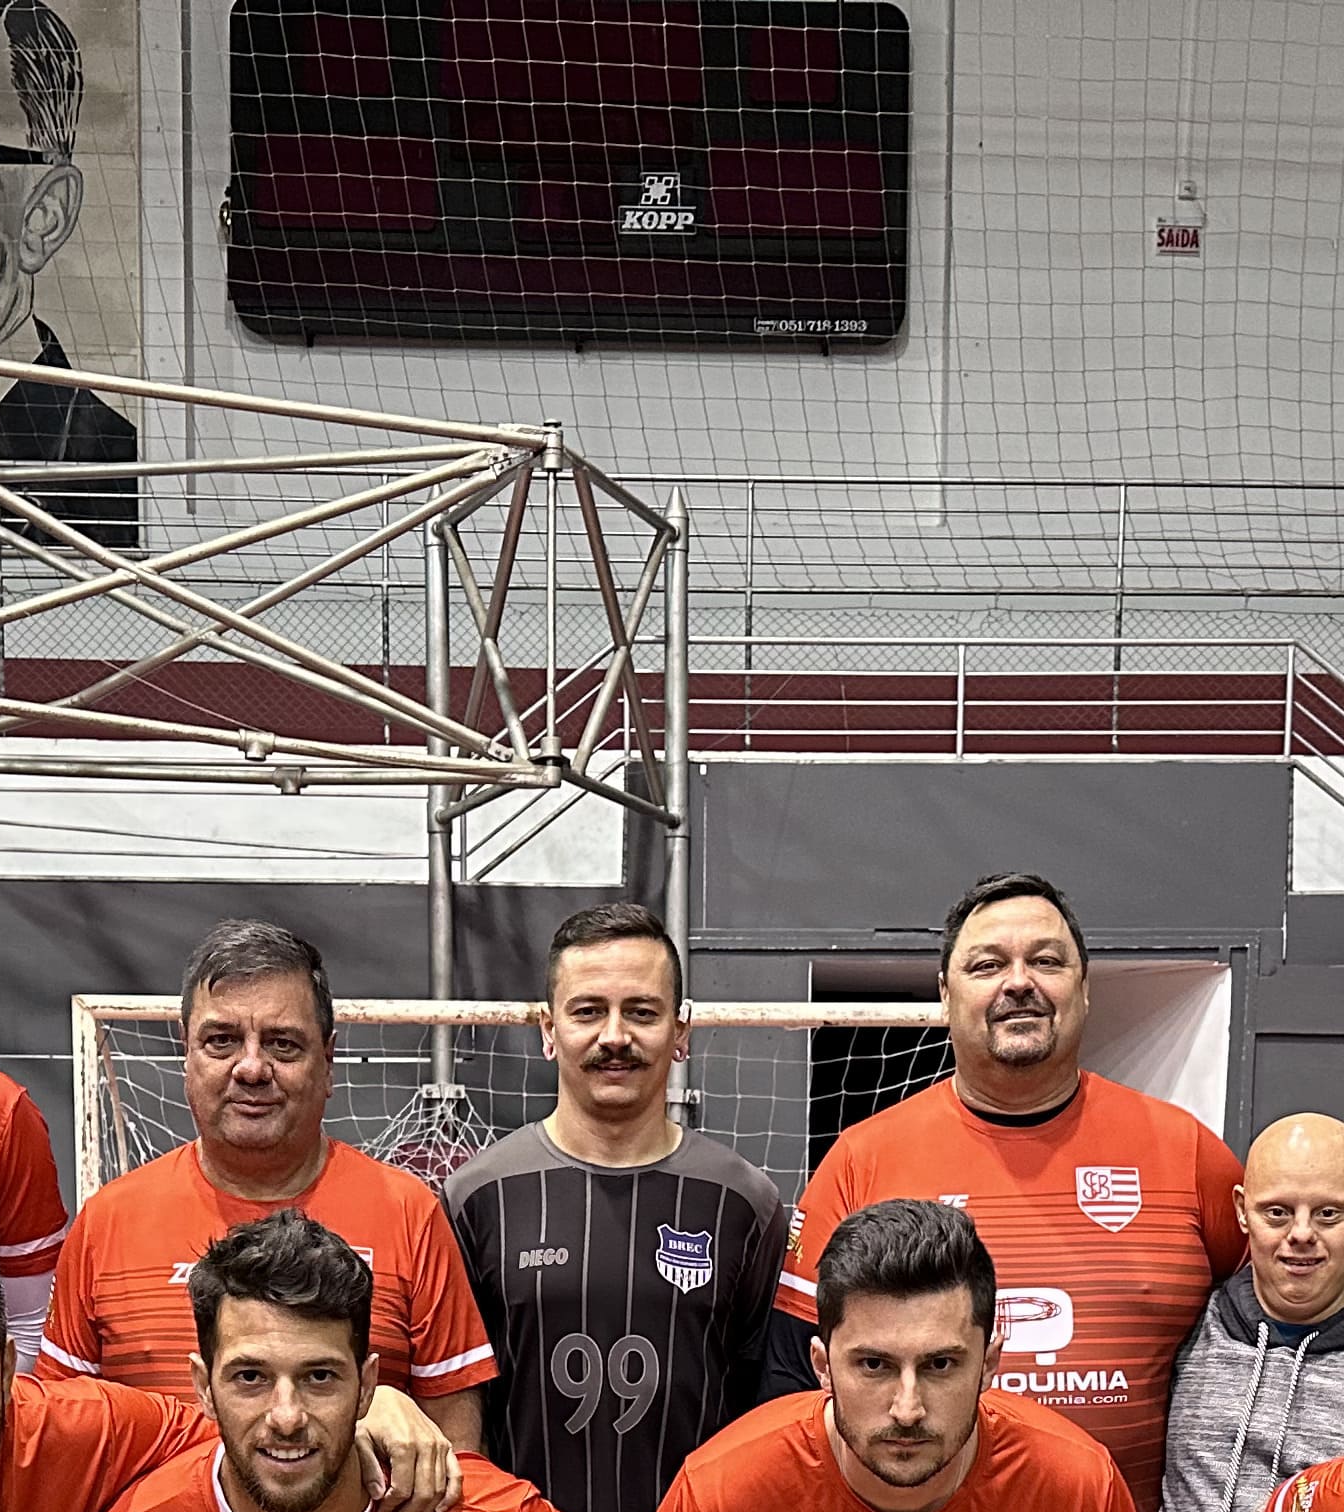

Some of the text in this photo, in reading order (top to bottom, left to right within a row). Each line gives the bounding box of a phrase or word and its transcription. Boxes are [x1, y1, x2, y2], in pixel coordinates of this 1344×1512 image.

[622, 211, 694, 230] KOPP
[518, 1247, 569, 1270] DIEGO
[551, 1333, 659, 1435] 99
